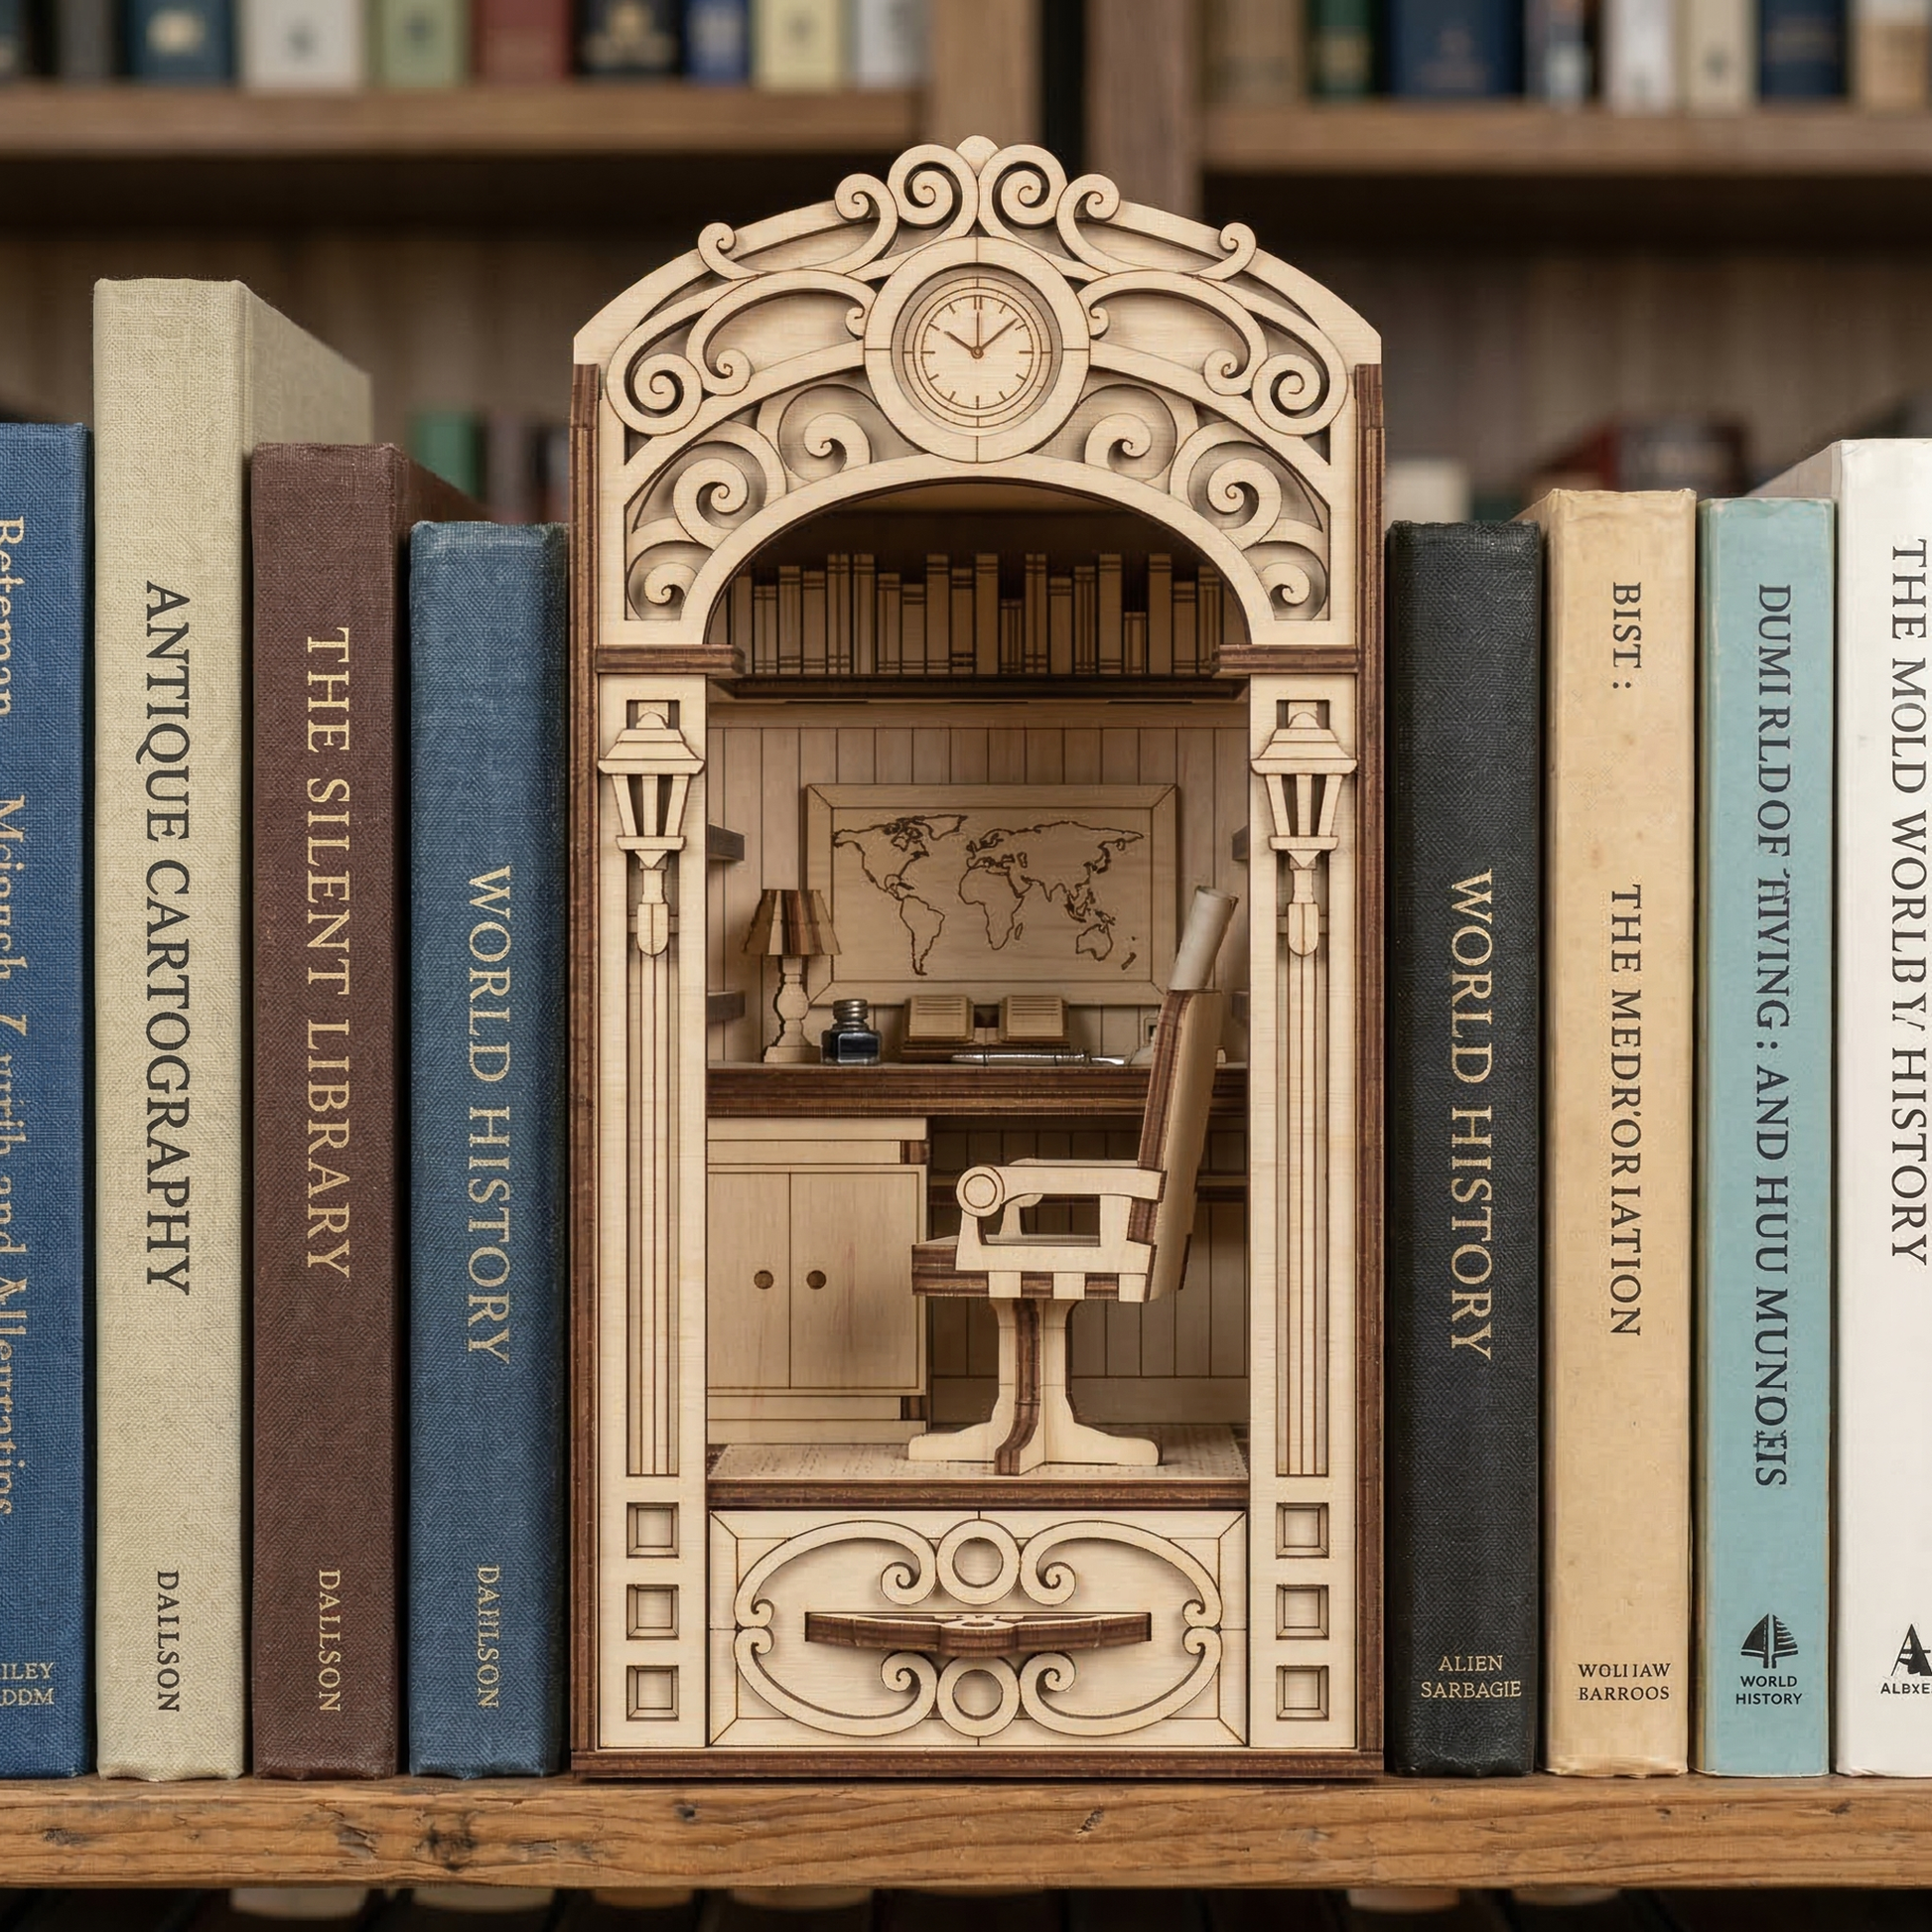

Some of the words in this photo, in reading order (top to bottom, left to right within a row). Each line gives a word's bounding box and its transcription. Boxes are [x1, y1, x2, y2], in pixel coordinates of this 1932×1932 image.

[1893, 539, 1928, 640] THE
[136, 581, 192, 843] ANTIQUE
[308, 627, 351, 755] THE
[1893, 658, 1928, 795] MOLD
[308, 778, 351, 997] SILENT
[1612, 885, 1642, 974] THE
[470, 867, 512, 1083] WORLD
[1451, 869, 1494, 1084] WORLD
[146, 860, 192, 1297] CARTOGRAPHY
[1757, 1065, 1791, 1162] AND
[308, 1020, 351, 1280] LIBRARY
[1893, 1048, 1928, 1267] HISTORY
[469, 1108, 511, 1362] HISTORY
[1451, 1106, 1494, 1360] HISTORY
[1757, 1176, 1790, 1275] HUU
[0, 1662, 55, 1680] ILEY
[0, 1688, 55, 1707] DDM
[319, 1570, 343, 1713] DALLSON
[1421, 1681, 1522, 1699] SARBAGIE
[1439, 1655, 1504, 1673] ALIEN
[1579, 1687, 1671, 1702] BARROOS
[1740, 1675, 1798, 1688] WORLD
[1880, 1683, 1932, 1696] ALBXE
[1735, 1694, 1802, 1706] HISTORY
